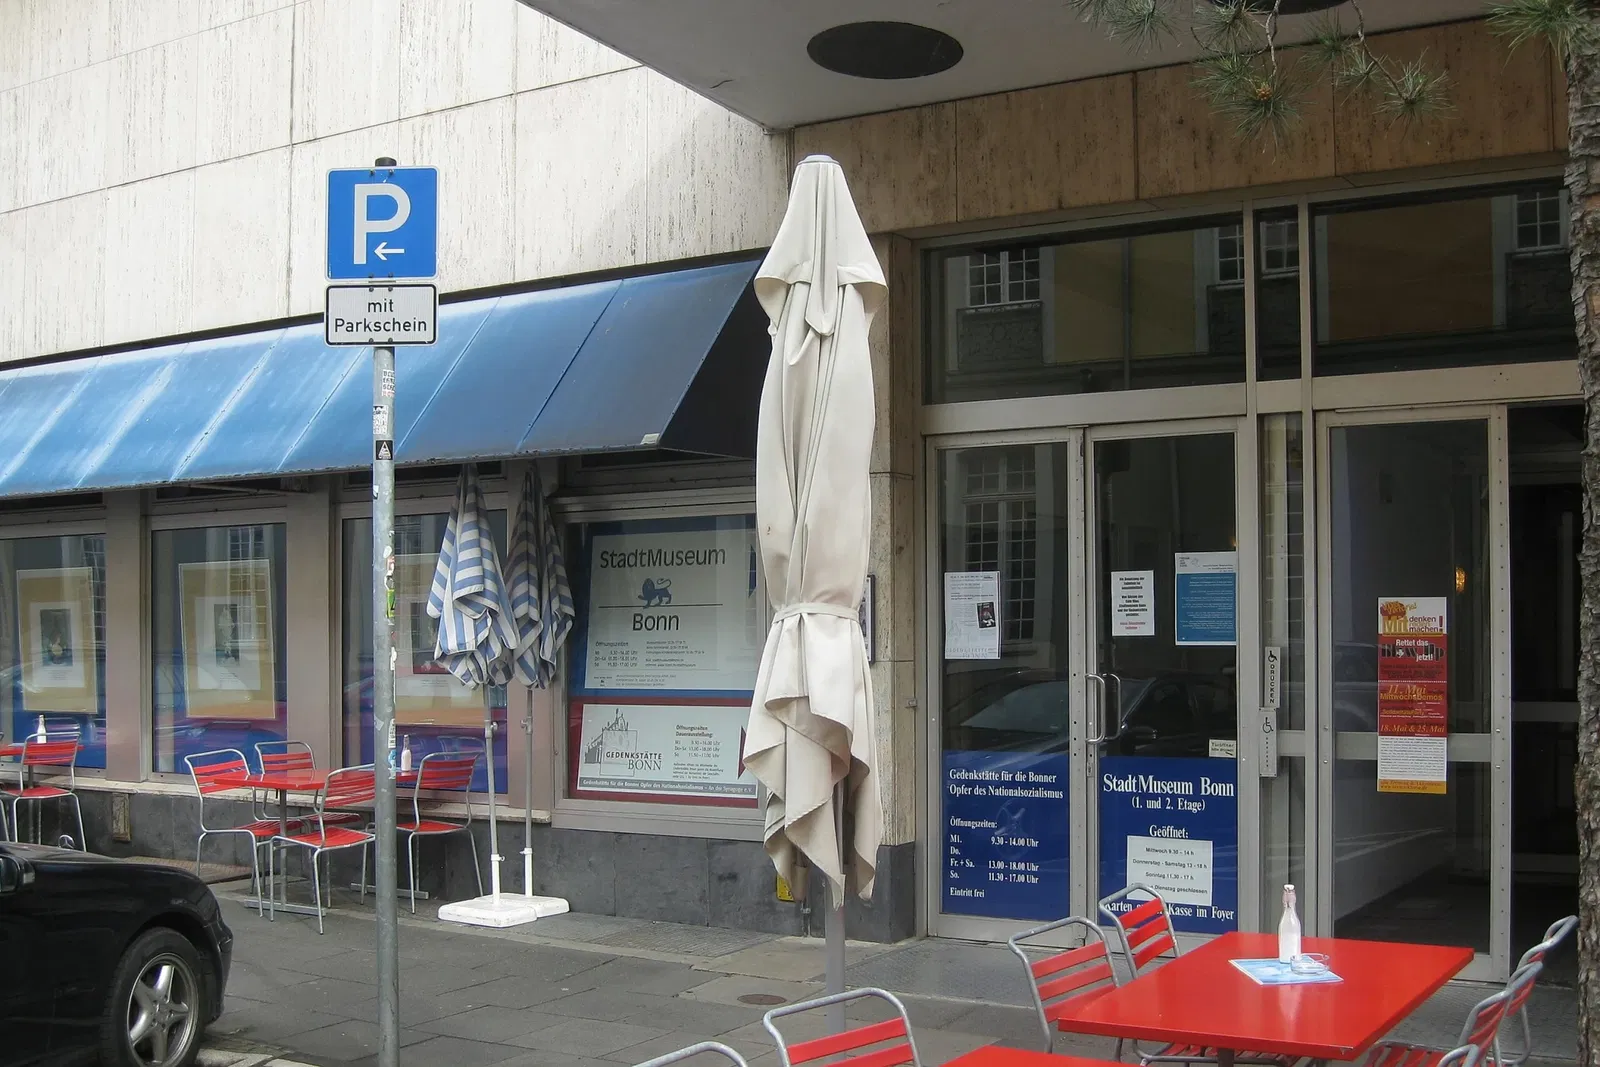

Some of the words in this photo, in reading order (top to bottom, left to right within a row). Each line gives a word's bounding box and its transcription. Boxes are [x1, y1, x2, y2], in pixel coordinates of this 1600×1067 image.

[354, 183, 411, 264] P
[368, 298, 394, 313] mit
[334, 318, 427, 332] Parkschein
[600, 548, 726, 568] StadtMuseum
[632, 613, 680, 631] Bonn
[1416, 654, 1433, 662] jetzt!
[1405, 685, 1426, 694] Mai
[606, 751, 662, 760] GEDENKSTÄTTE
[628, 760, 662, 771] BONN
[950, 769, 999, 781] Gedenkstätte
[1001, 771, 1013, 781] für
[1015, 771, 1026, 782] die
[1028, 772, 1056, 783] Bonner
[949, 784, 972, 798] Opfer
[974, 785, 986, 796] des
[988, 785, 1063, 799] Nationalsozialismus
[1200, 777, 1234, 797] Bonn
[1132, 796, 1143, 808] (1.
[1146, 798, 1161, 809] und
[1166, 798, 1174, 809] 2.
[1178, 799, 1205, 813] Etage)
[950, 816, 998, 829] Öffnungszeiten:
[1149, 825, 1189, 838] Geöffnet:
[991, 836, 1003, 845] 9.30
[1009, 837, 1025, 846] 14.00
[1027, 838, 1039, 848] Uhr
[950, 846, 960, 855] Do.
[950, 858, 959, 867] Fr.
[965, 859, 975, 868] Sa.
[988, 860, 1004, 869] 13.00
[1009, 861, 1025, 870] 18.00
[1027, 862, 1039, 872] Uhr
[950, 870, 959, 879] So.
[988, 872, 1003, 881] 11.30
[1009, 873, 1025, 882] 17.00
[1026, 874, 1039, 883] Uhr
[950, 887, 973, 897] Eintritt
[974, 888, 985, 898] frei
[1168, 903, 1193, 917] Kasse
[1196, 905, 1207, 918] im
[1212, 906, 1234, 921] Foyer
